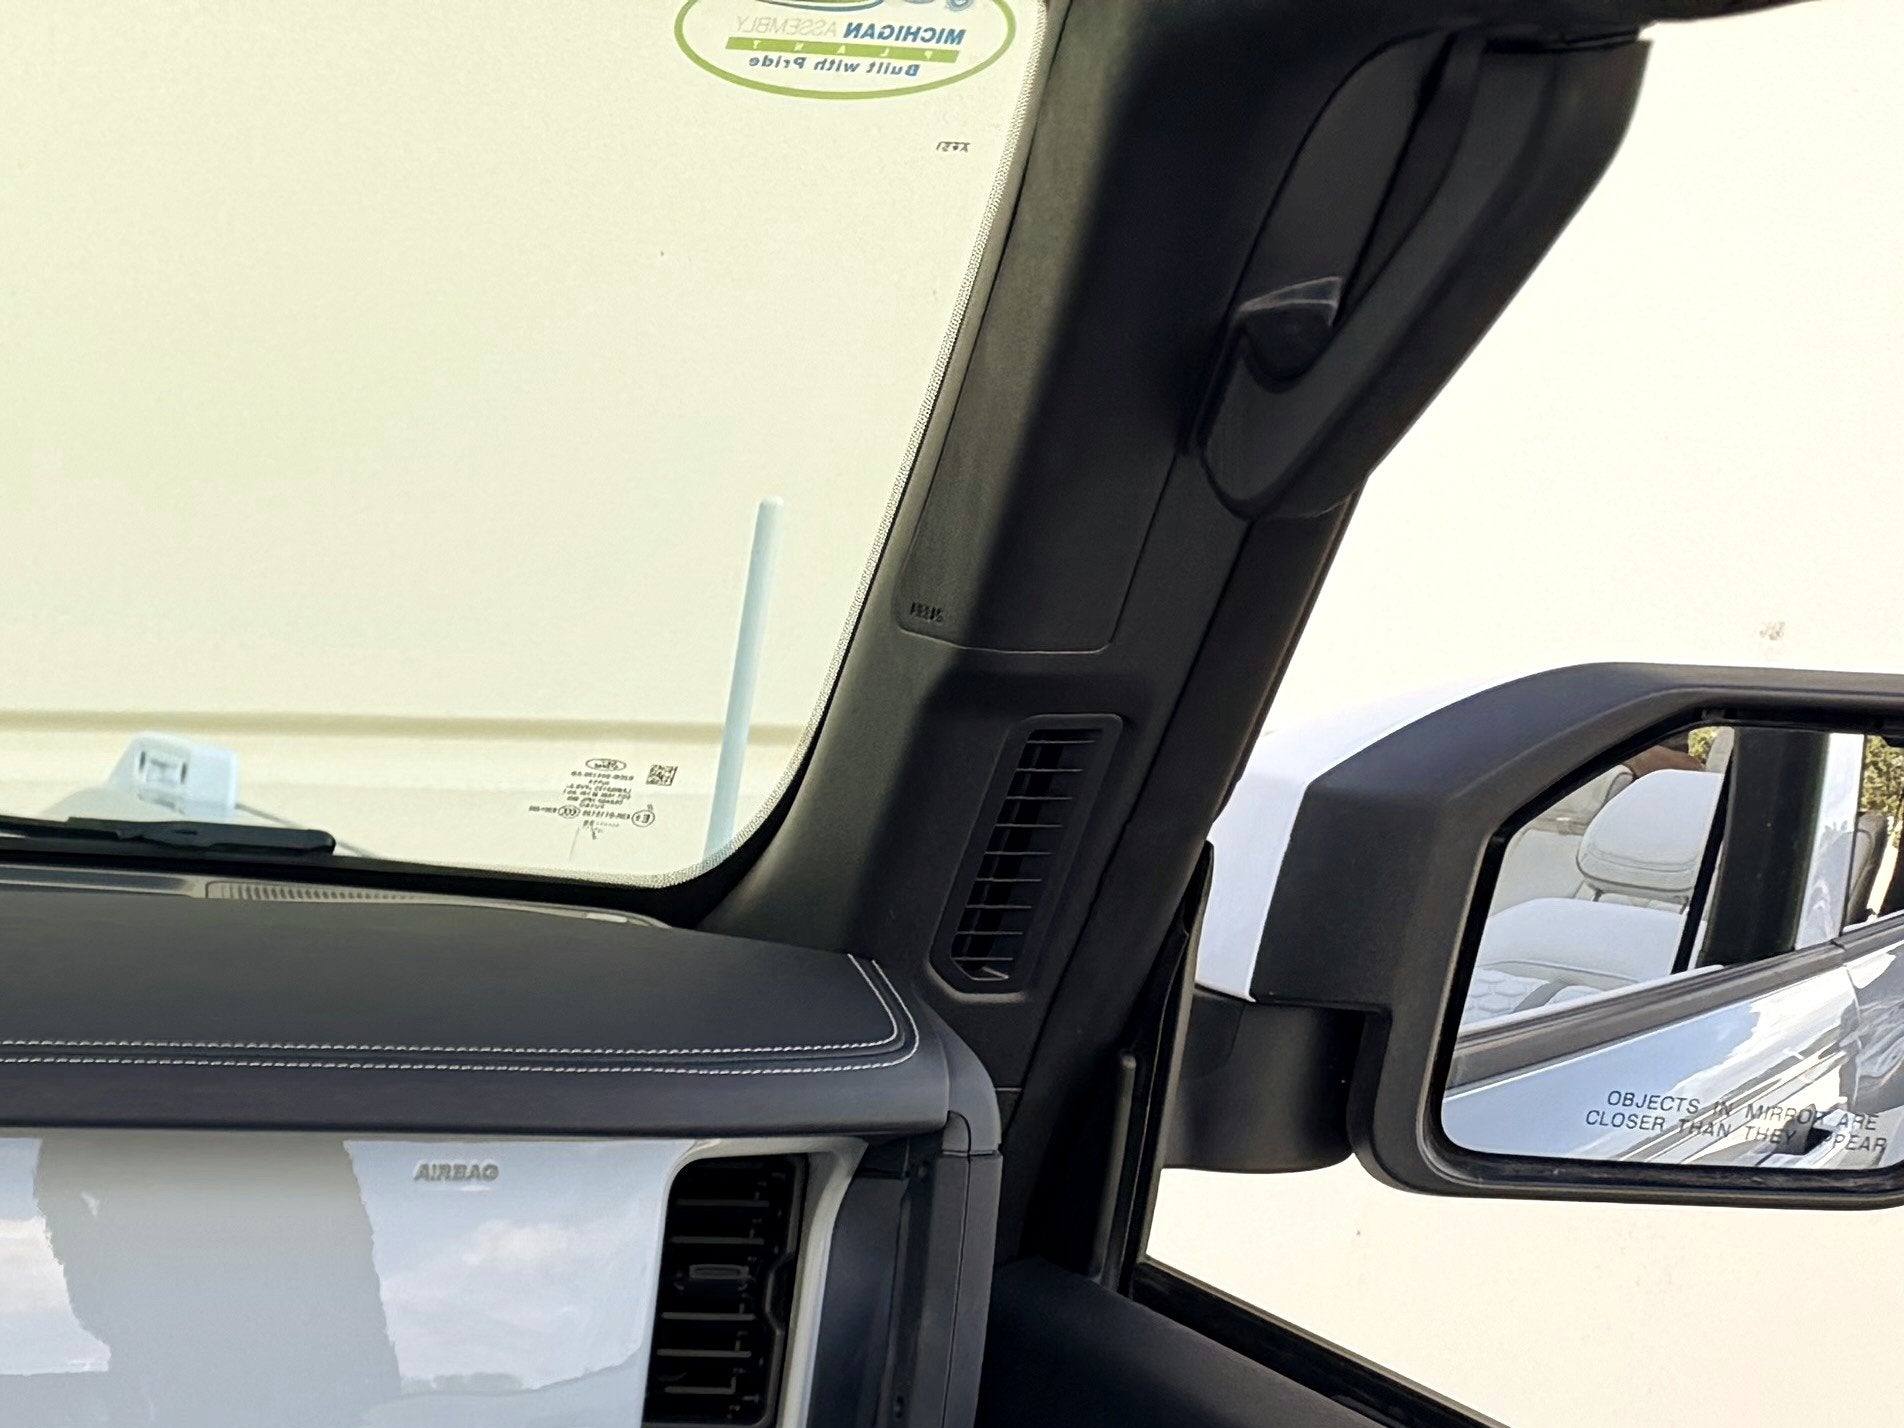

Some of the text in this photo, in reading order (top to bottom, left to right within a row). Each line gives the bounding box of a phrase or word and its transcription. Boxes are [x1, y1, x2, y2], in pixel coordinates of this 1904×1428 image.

[1585, 1109, 1666, 1132] CLOSER
[1678, 1118, 1732, 1139] THAN
[1743, 1125, 1797, 1146] THEY
[1606, 1090, 1701, 1114] OBJECTS
[1712, 1101, 1733, 1117] IN
[1836, 1112, 1880, 1131] ARE
[413, 1162, 500, 1181] AIRBAG
